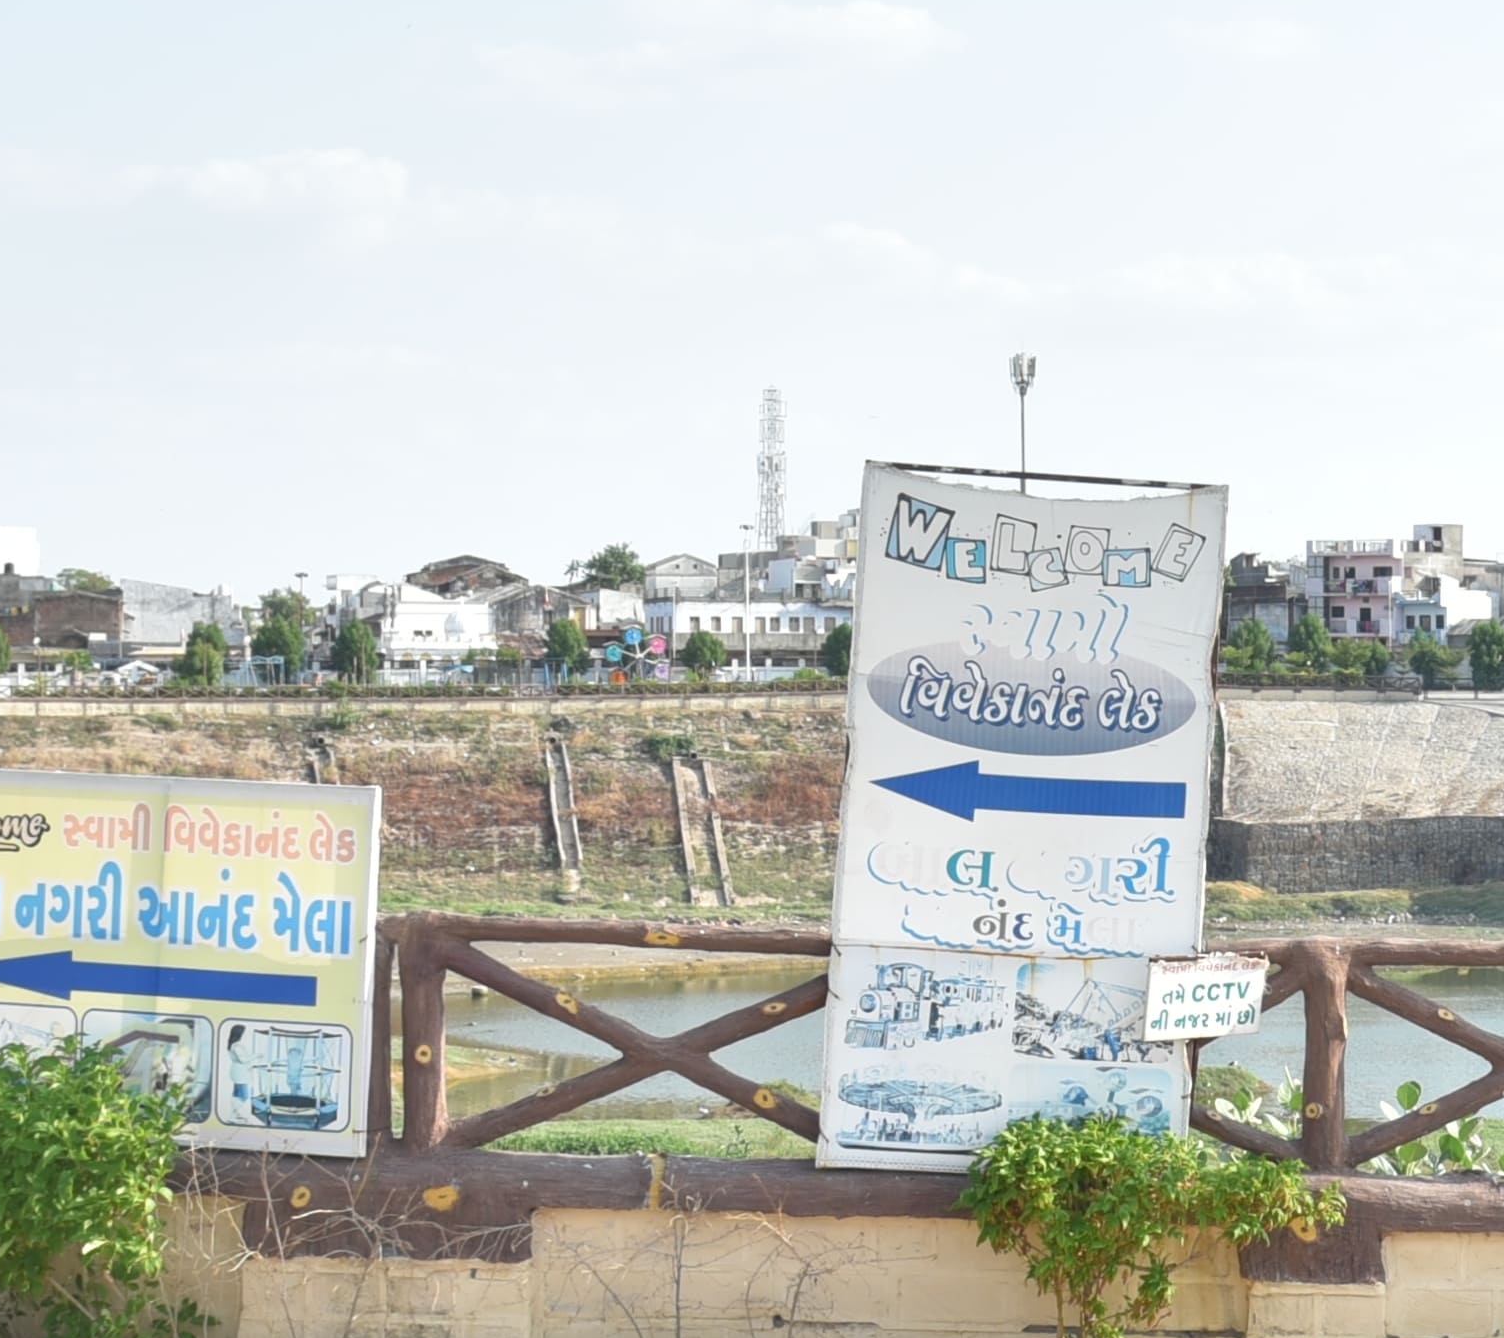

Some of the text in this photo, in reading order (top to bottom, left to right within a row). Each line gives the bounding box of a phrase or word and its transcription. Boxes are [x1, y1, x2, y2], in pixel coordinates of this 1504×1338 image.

[885, 493, 1206, 592] WELCOME
[900, 655, 1164, 733] વિવેકાનંદ લેક
[63, 804, 357, 863] સ્વામી વિવેકાનંદ લેક
[15, 861, 123, 941] નગરી
[138, 868, 258, 951] આનંદ
[273, 871, 352, 955] મેલા
[1150, 1009, 1169, 1030] ની
[1237, 1003, 1256, 1025] છો
[1162, 981, 1250, 1005] તમે CCTV
